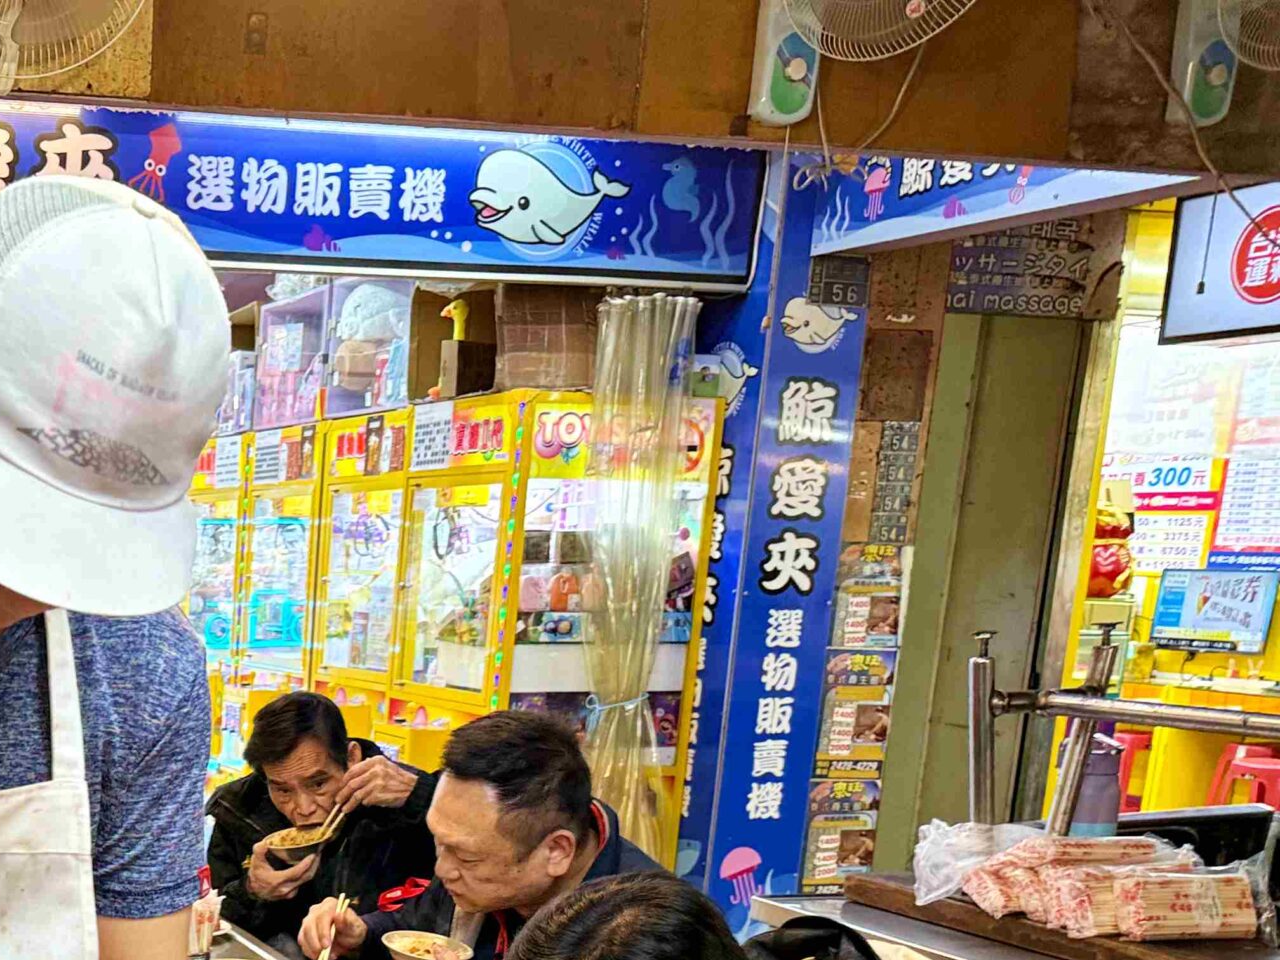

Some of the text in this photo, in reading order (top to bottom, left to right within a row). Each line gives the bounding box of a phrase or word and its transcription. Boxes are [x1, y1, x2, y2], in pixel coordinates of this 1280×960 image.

[559, 136, 598, 171] WHITE
[186, 153, 447, 224] 選物販賣機
[571, 211, 604, 258] WHALE
[831, 283, 859, 304] 56
[983, 292, 1082, 315] massage
[761, 380, 837, 593] 鯨愛夾
[745, 607, 805, 821] 選物販賣機
